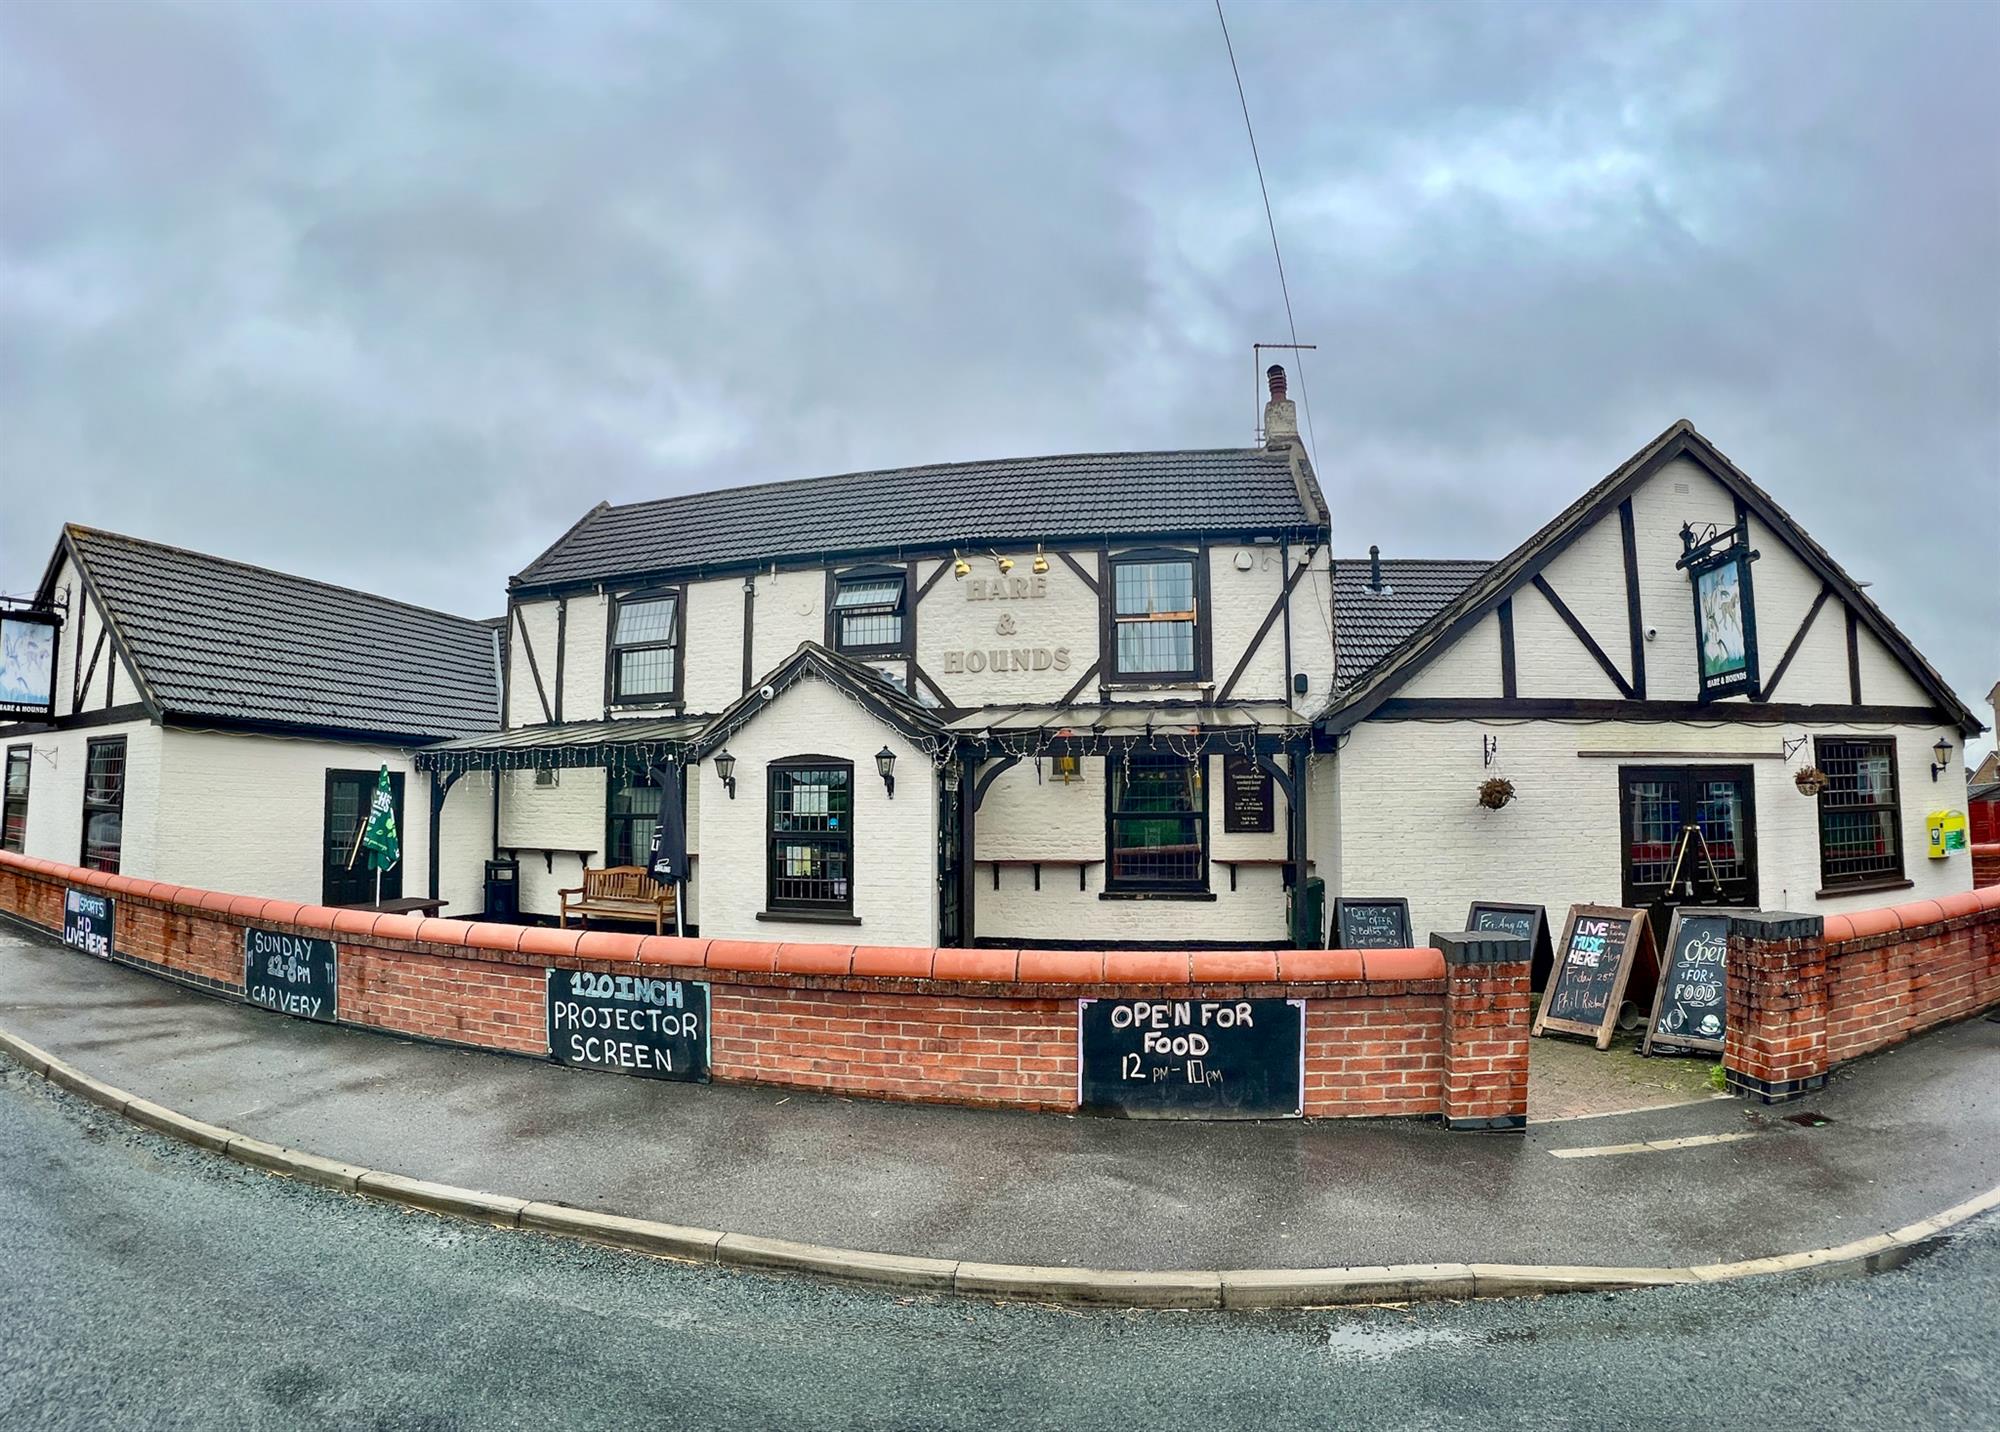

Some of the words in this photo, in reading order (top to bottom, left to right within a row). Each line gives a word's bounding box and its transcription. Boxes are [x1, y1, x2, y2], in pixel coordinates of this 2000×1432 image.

[966, 576, 1047, 601] HARE
[996, 613, 1017, 636] &
[944, 647, 1071, 674] HOUNDS
[1707, 678, 1720, 688] HARE
[1721, 676, 1725, 684] &
[1725, 671, 1747, 684] HOUNDS
[80, 897, 105, 917] SPORTS
[78, 916, 91, 932] HD
[1577, 920, 1609, 936] LIVE
[66, 926, 84, 948] LIVE
[86, 932, 108, 957] HERE
[255, 932, 312, 961] SUNDAY
[1572, 936, 1605, 954] MUSIC
[1685, 931, 1727, 968] Open
[1568, 949, 1600, 967] HERE
[1602, 947, 1620, 971] Aug
[1686, 970, 1707, 982] FOR
[252, 985, 321, 1017] CARVERY
[1557, 990, 1578, 1011] Phil
[1675, 984, 1715, 1001] FOOD
[555, 1002, 697, 1040] PROJECTOR
[1111, 1002, 1190, 1028] OPEN
[1201, 1002, 1253, 1028] FOR
[571, 1034, 673, 1072] SCREEN
[1144, 1032, 1209, 1056] FOOD
[1122, 1053, 1146, 1080] 12
